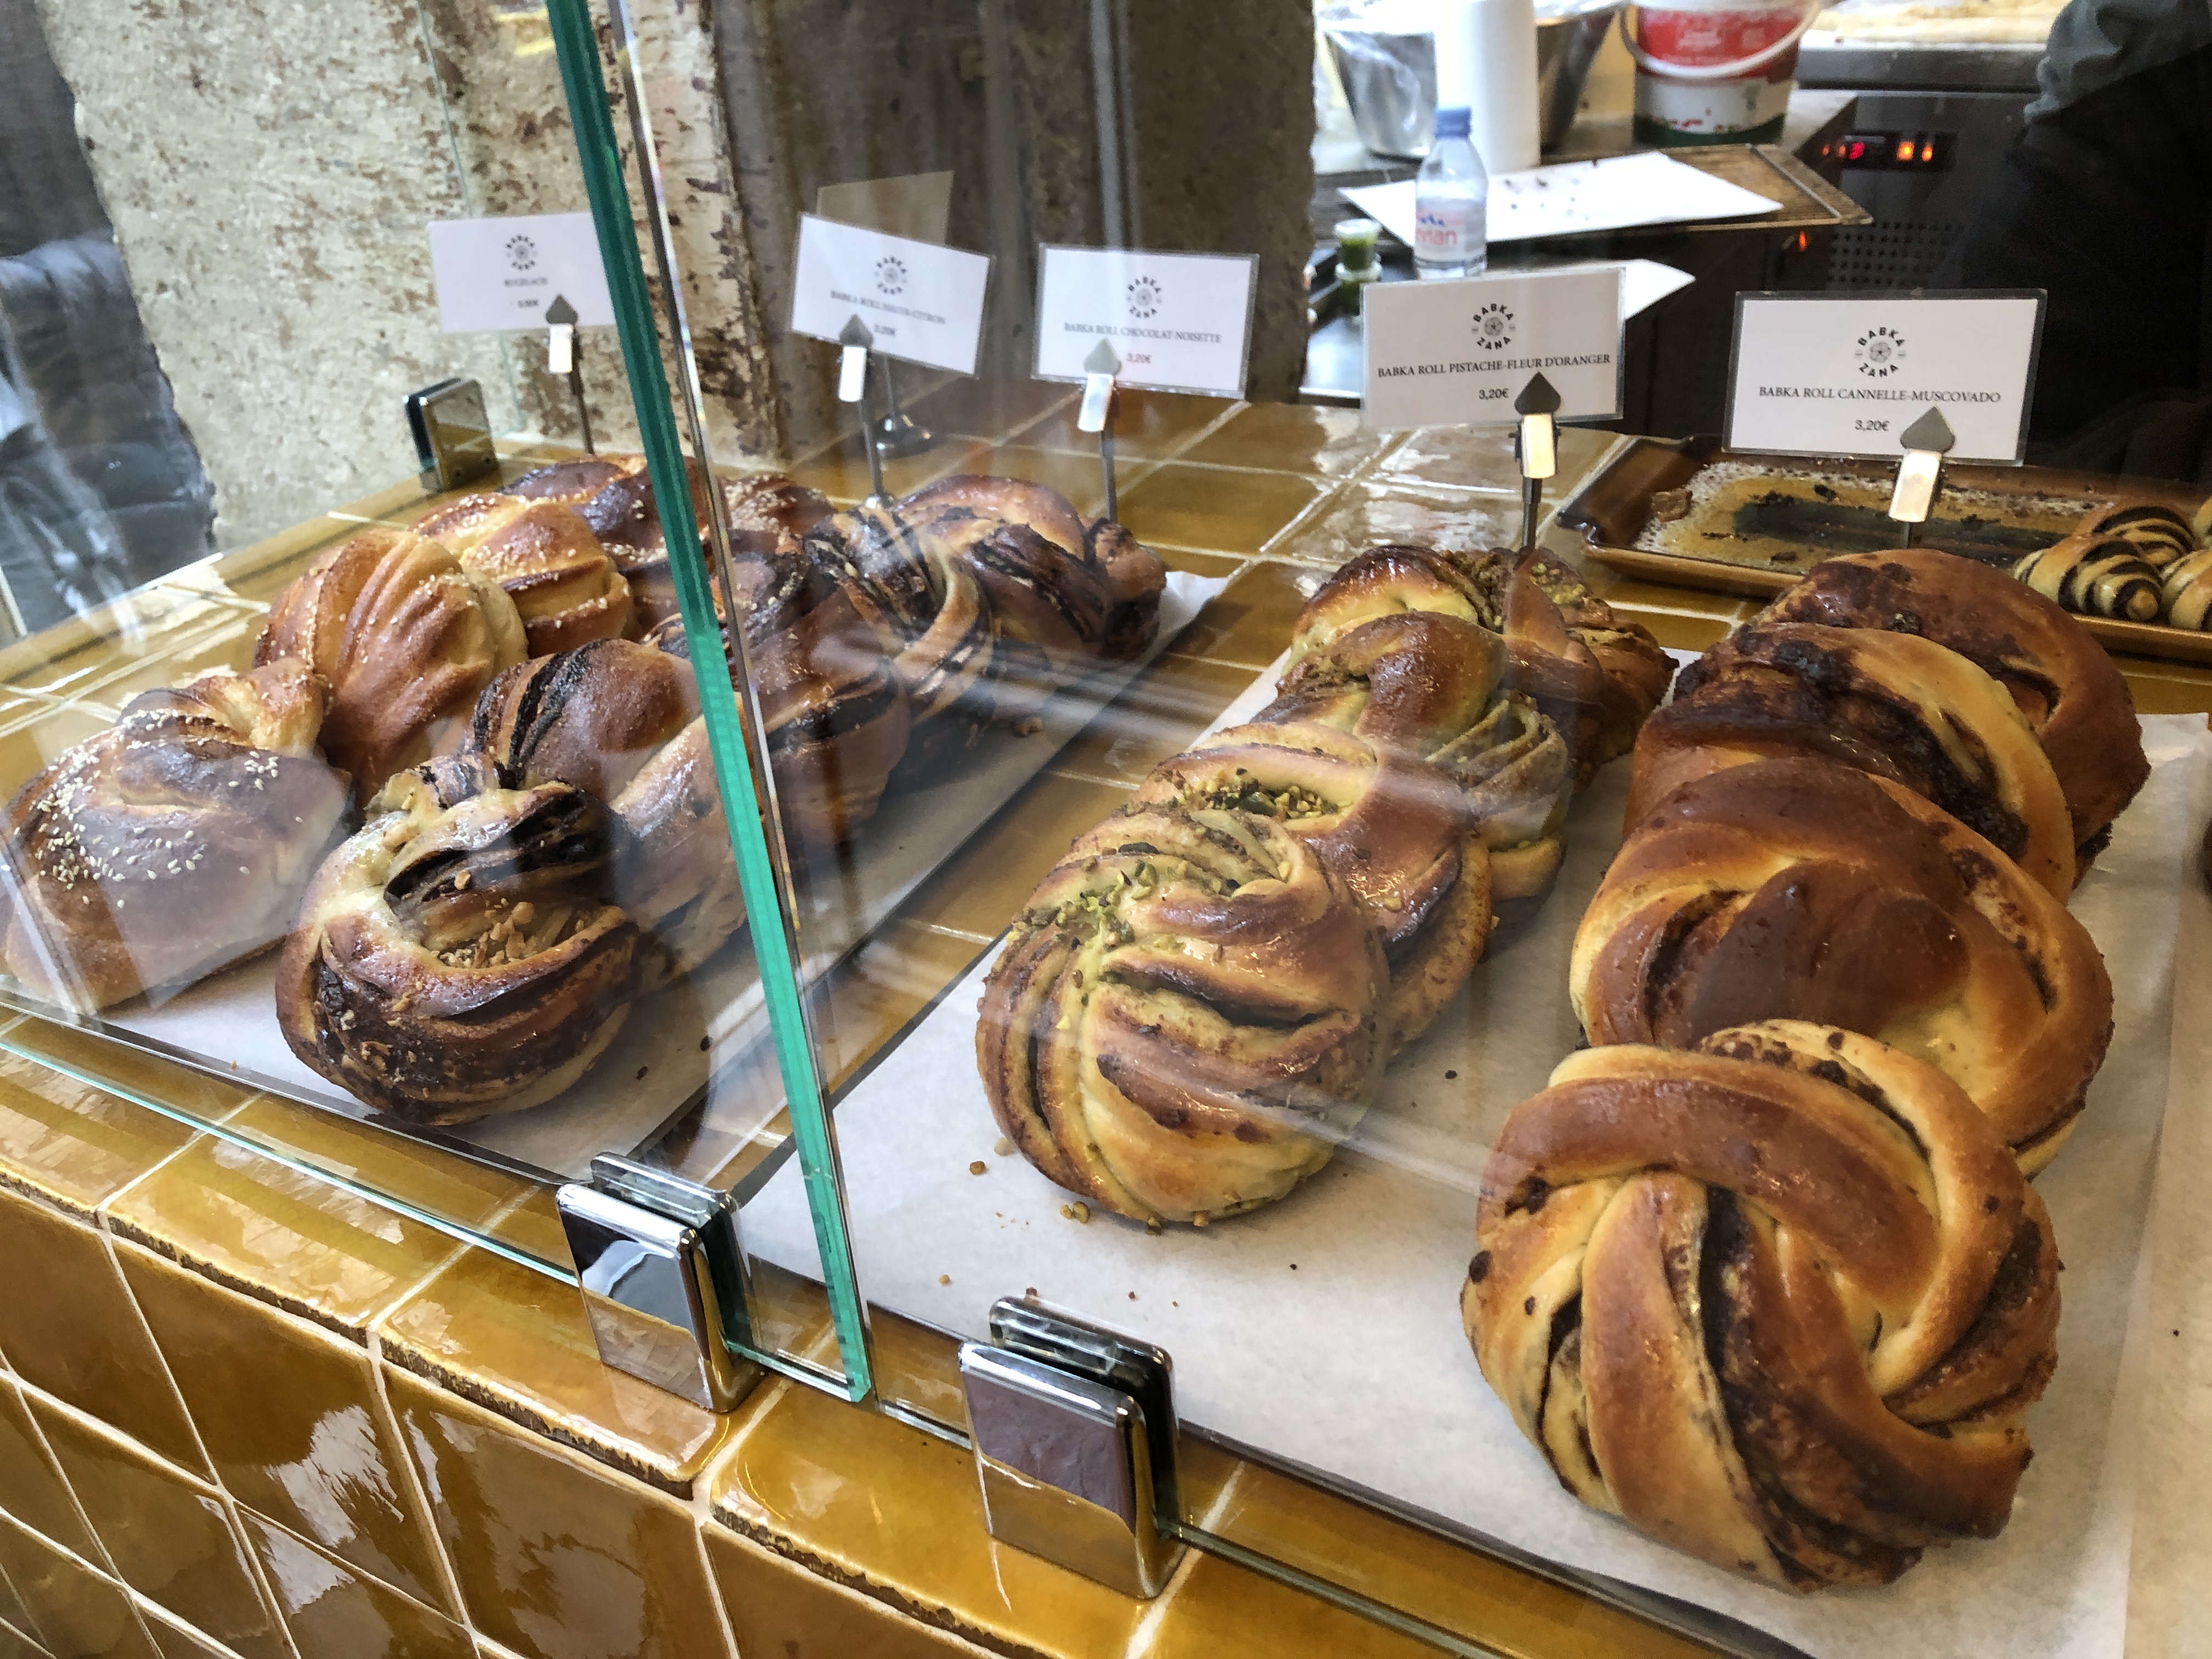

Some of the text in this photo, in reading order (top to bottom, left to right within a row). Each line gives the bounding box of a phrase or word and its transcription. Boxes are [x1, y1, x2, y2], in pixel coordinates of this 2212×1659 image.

[1472, 303, 1514, 323] BABKA
[1064, 322, 1094, 333] BABKA
[1096, 325, 1118, 335] ROLL
[1476, 336, 1511, 350] ZANA
[1858, 326, 1905, 347] BABKA
[1378, 353, 1611, 377] BABKA ROLL PISTACHE-FLEUR D'ORANGER
[1859, 362, 1899, 377] ZANA
[1479, 387, 1509, 400] 3,20€
[1759, 386, 2001, 403] BABKA ROLL CANNELLE-MUSCOVADO
[1855, 419, 1890, 431] 3,20€
